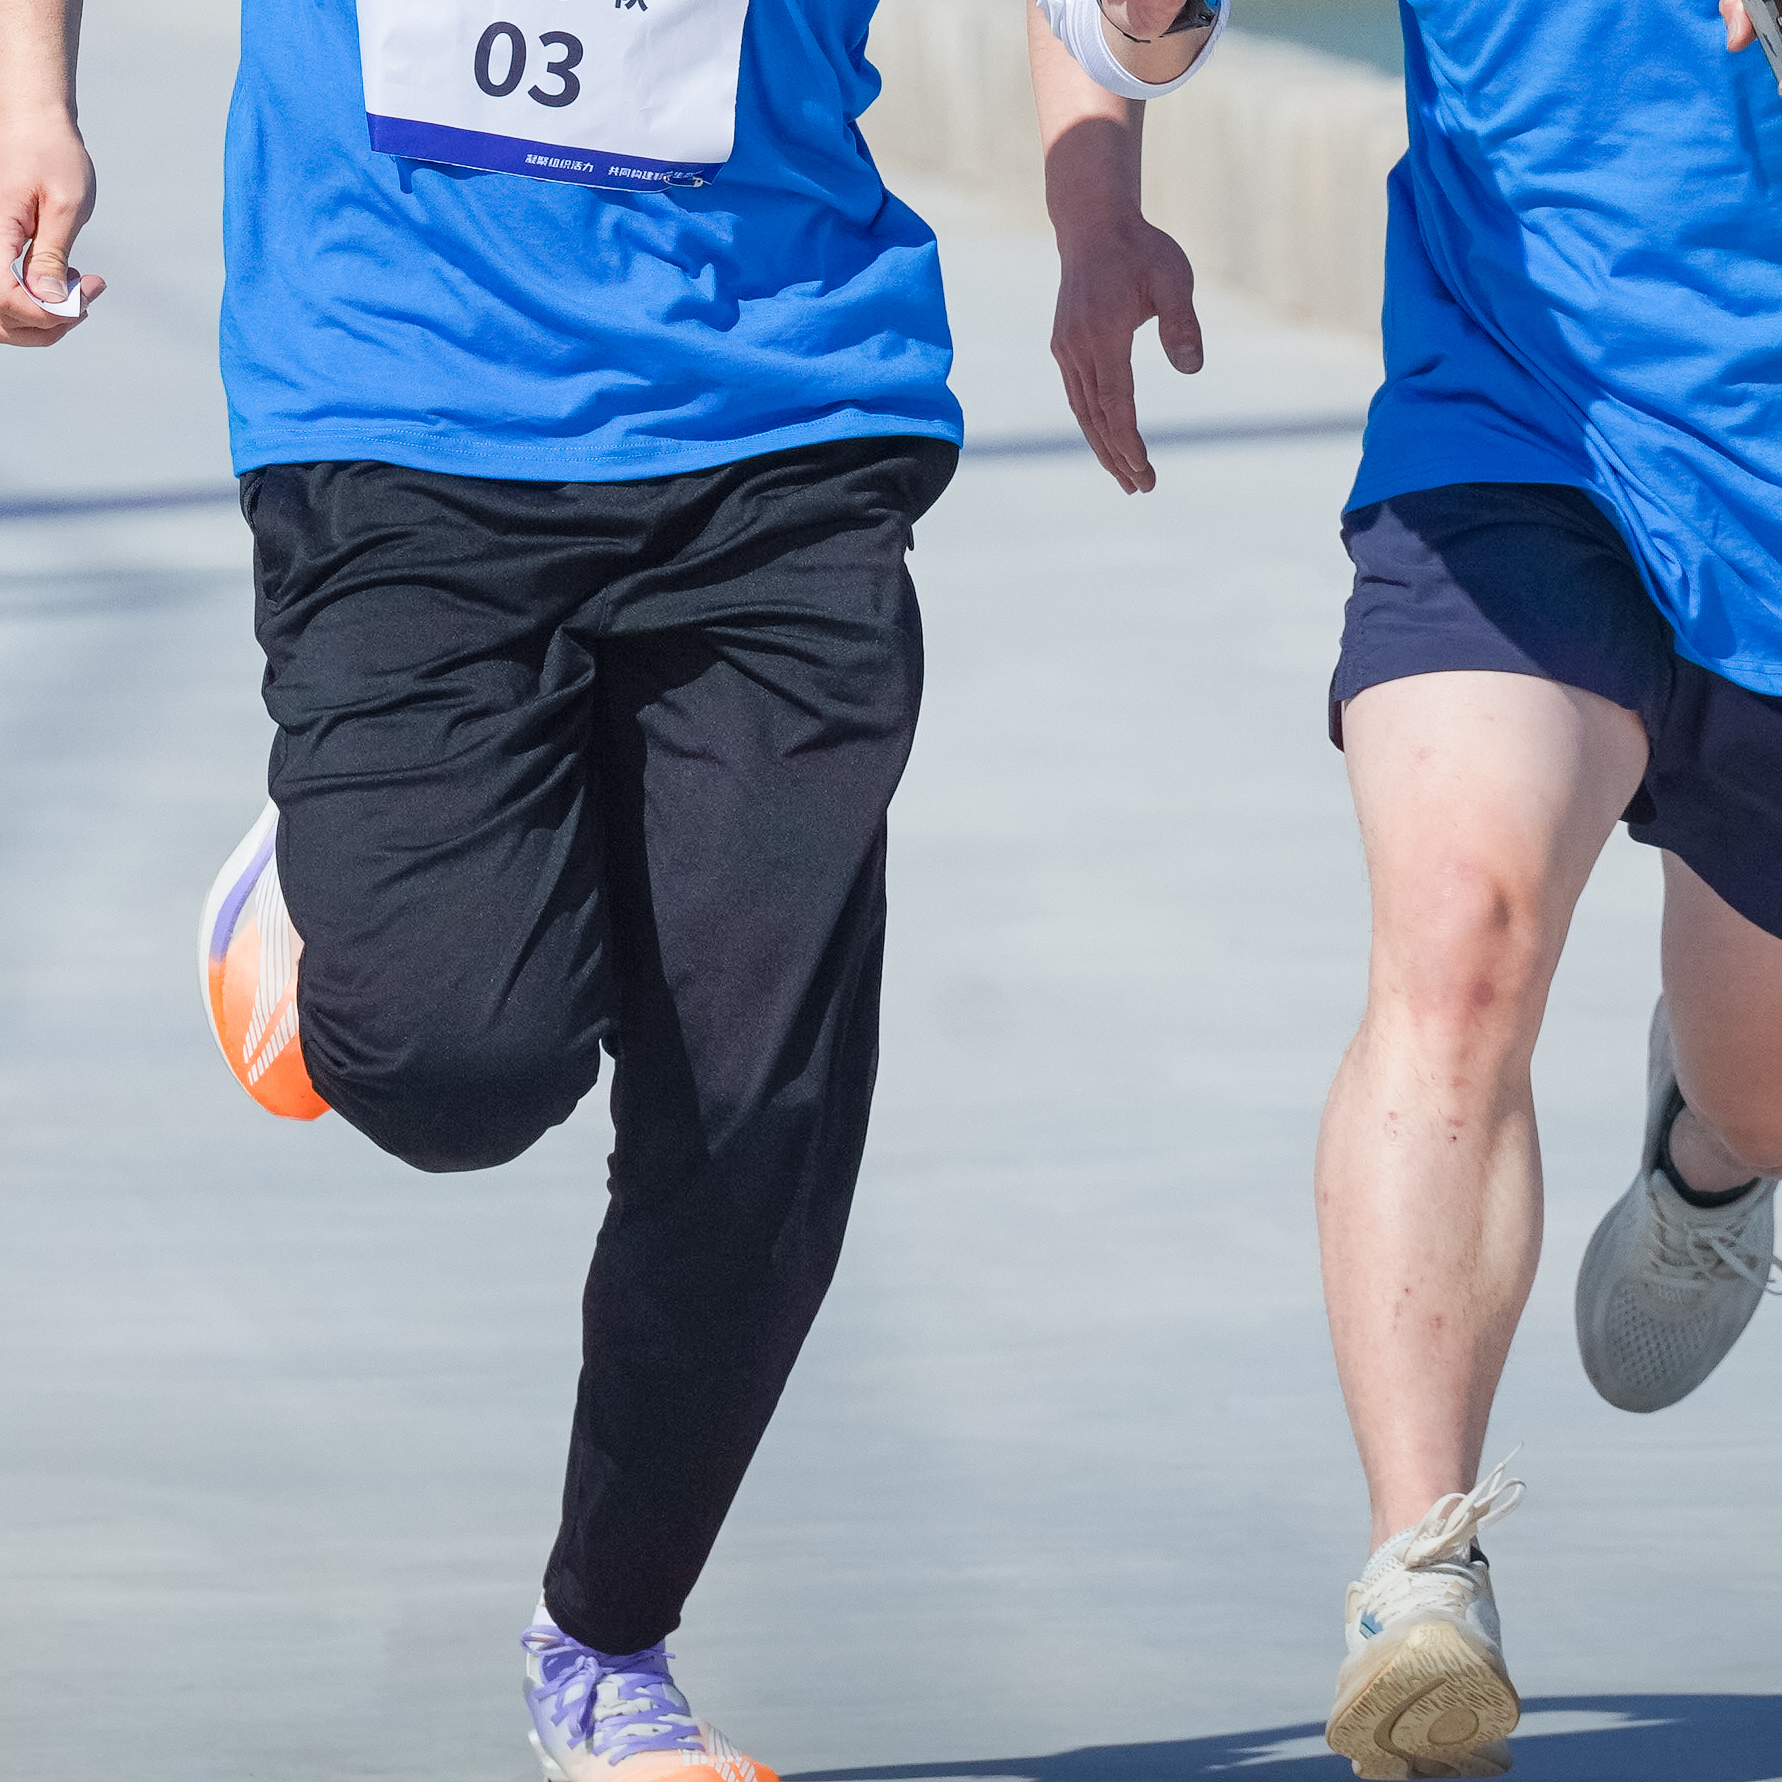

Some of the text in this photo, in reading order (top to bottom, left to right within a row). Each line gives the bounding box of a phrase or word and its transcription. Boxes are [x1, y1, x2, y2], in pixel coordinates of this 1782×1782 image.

[473, 21, 585, 108] 03
[525, 153, 594, 173] 凝聚组织活力
